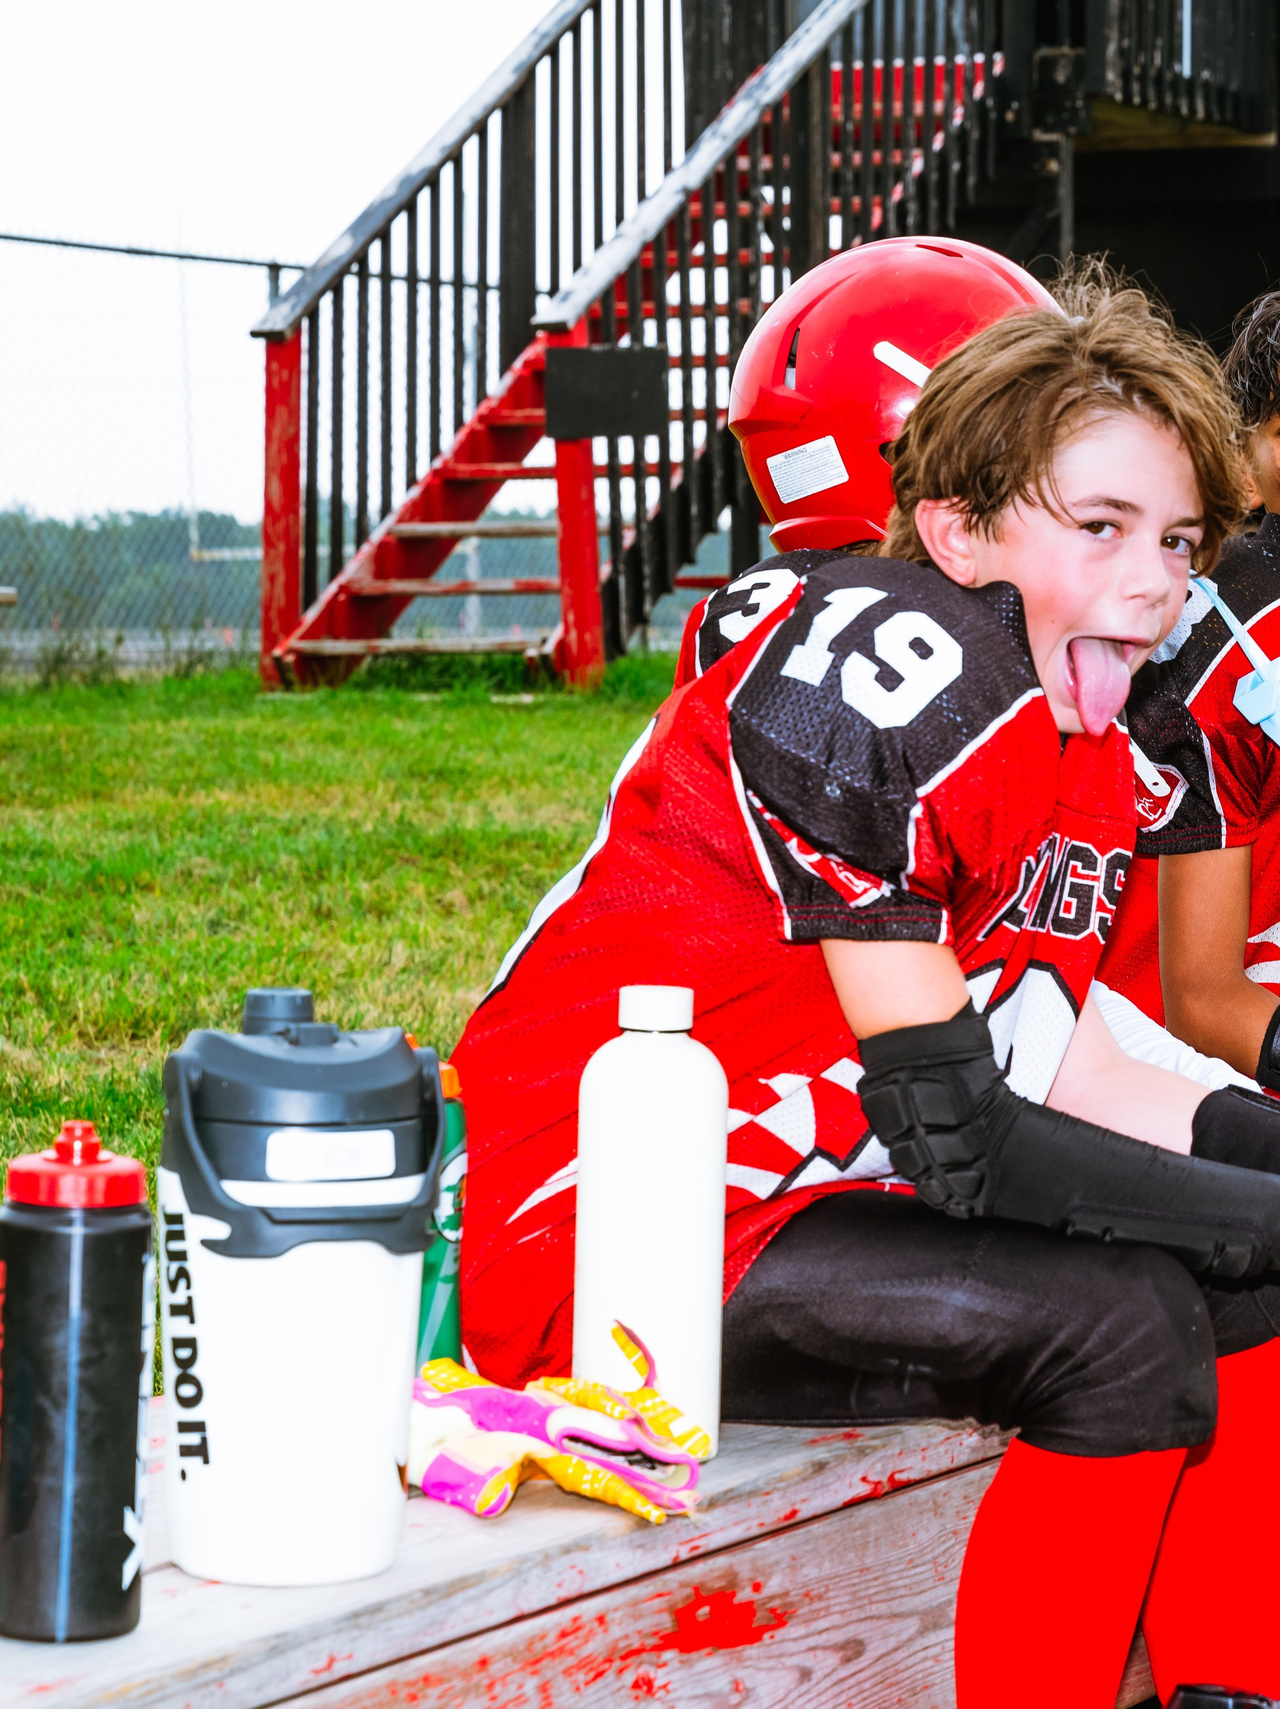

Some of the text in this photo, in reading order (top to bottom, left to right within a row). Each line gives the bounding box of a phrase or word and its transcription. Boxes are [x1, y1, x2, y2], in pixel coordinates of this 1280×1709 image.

[780, 586, 964, 730] 19
[162, 1204, 210, 1482] JUST DO IT.
